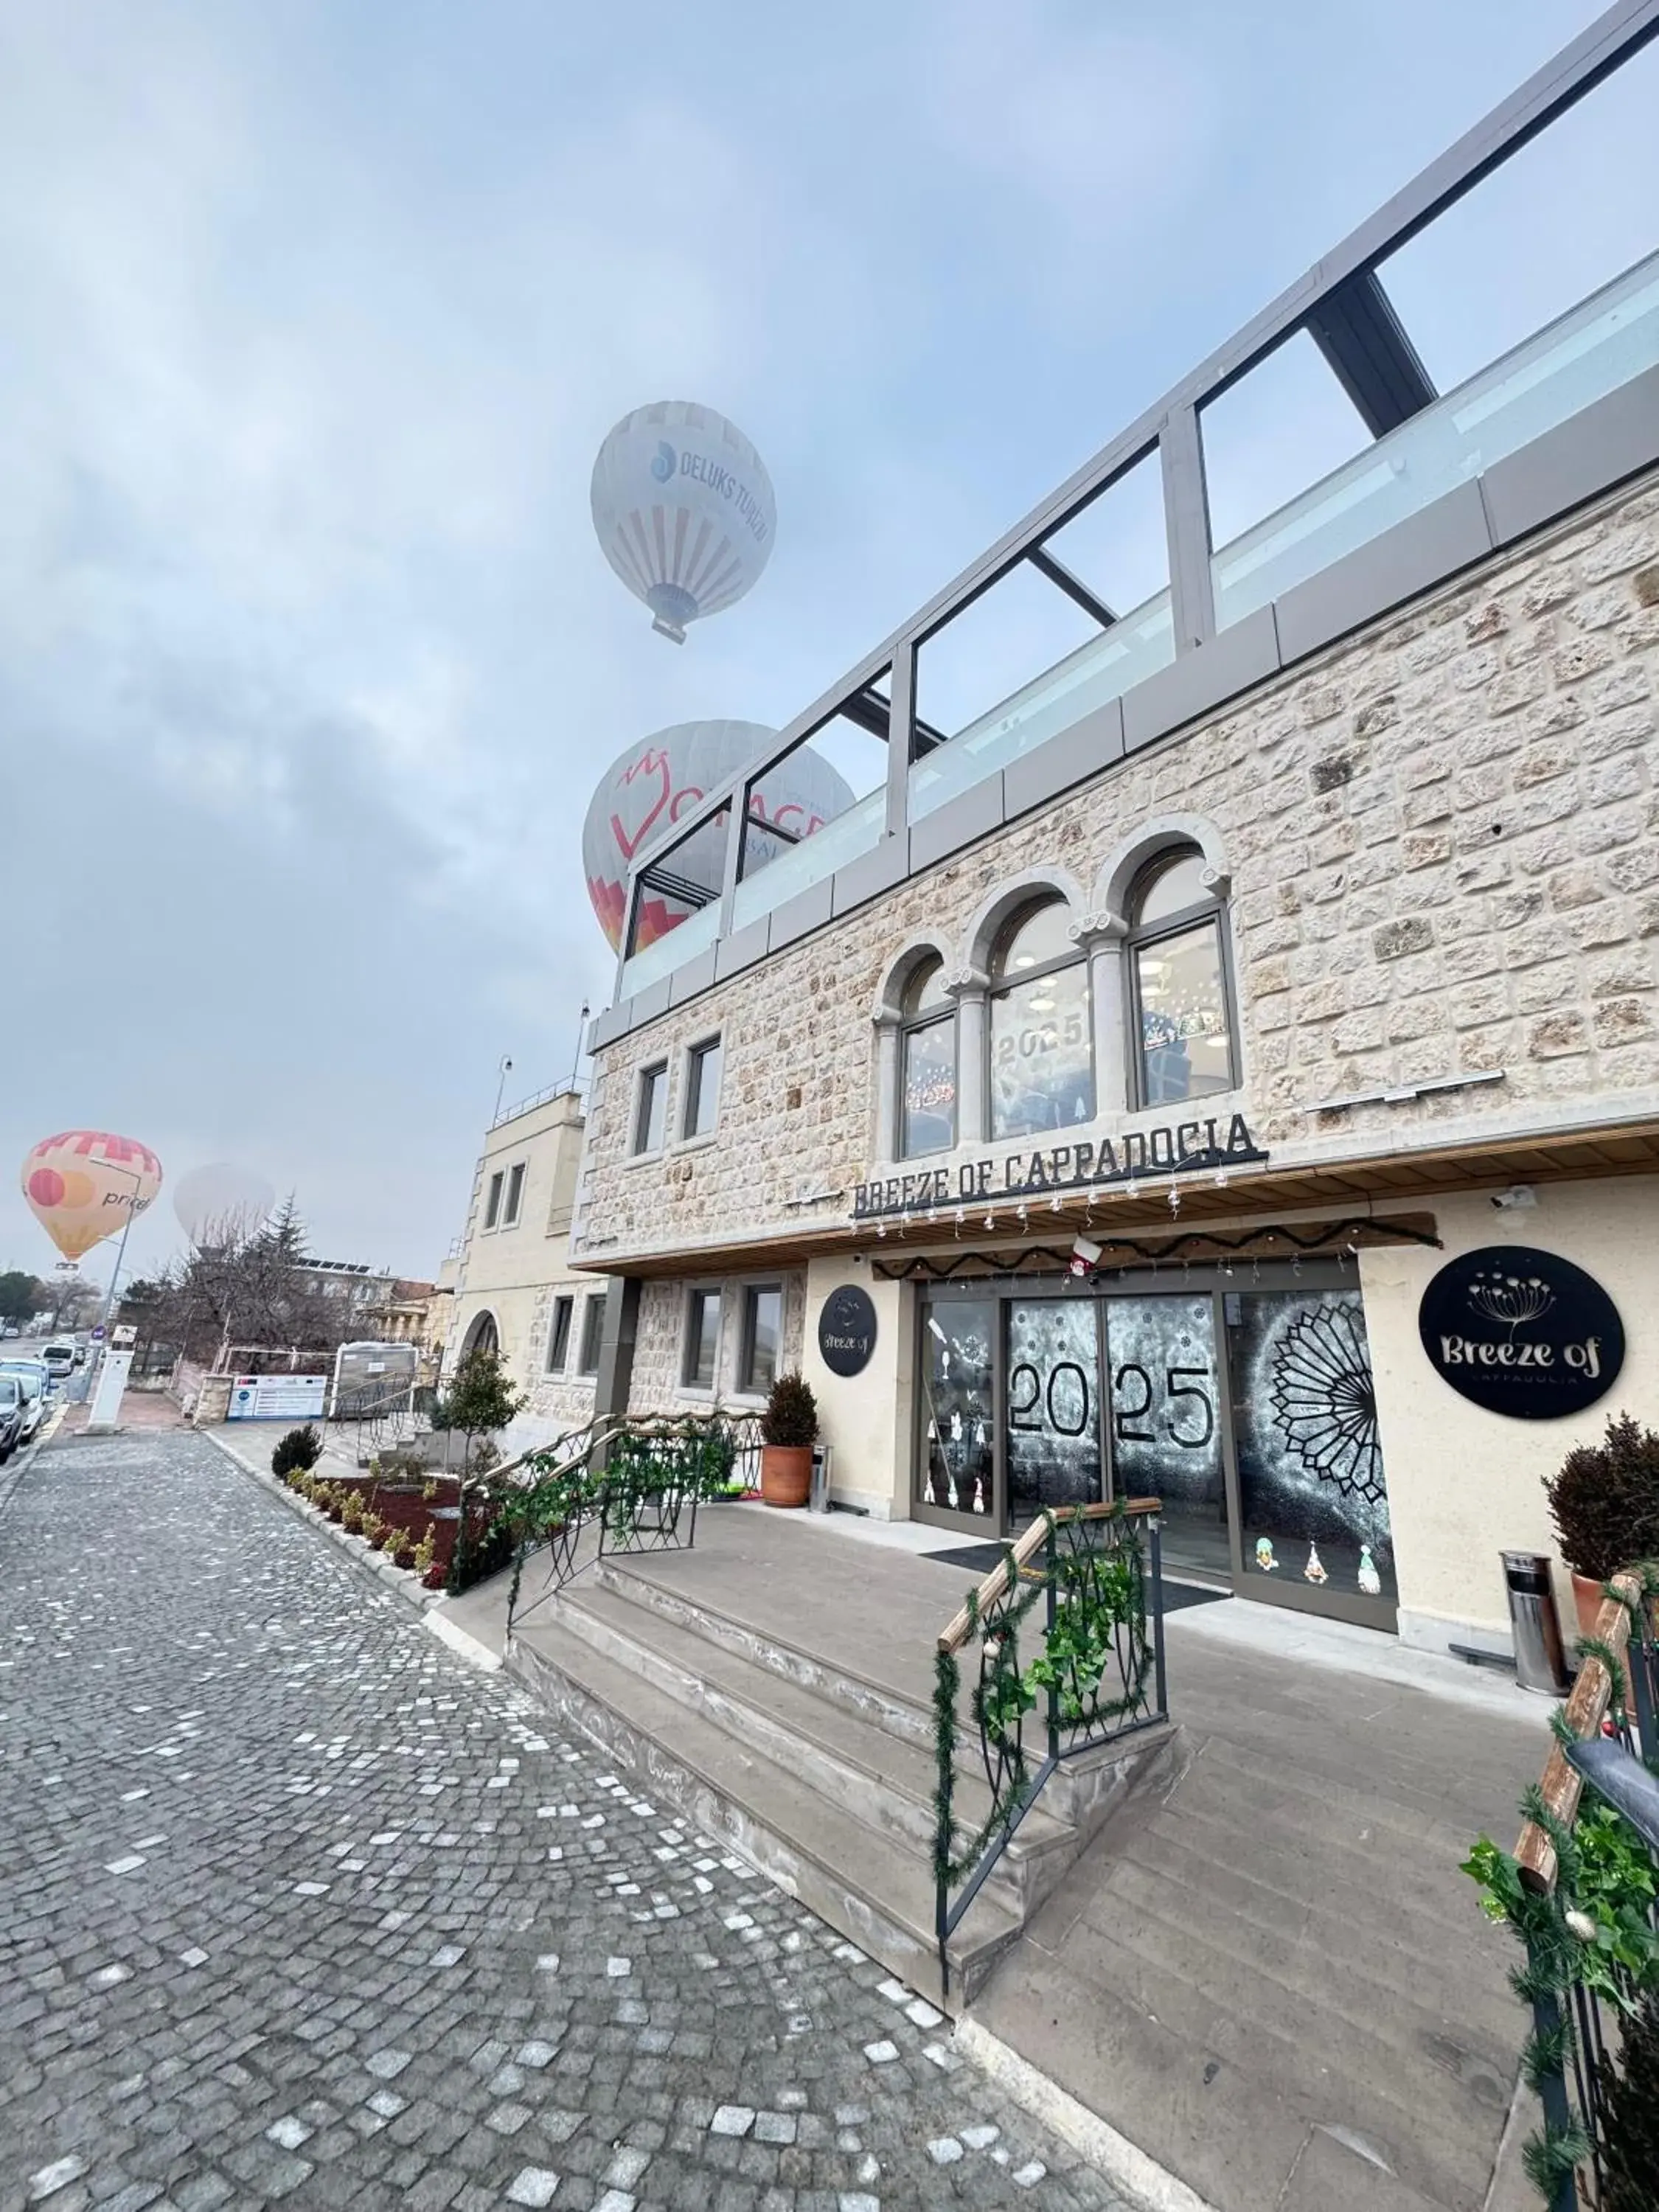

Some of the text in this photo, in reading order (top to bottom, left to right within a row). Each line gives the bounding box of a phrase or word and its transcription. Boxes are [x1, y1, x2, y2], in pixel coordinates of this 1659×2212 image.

[681, 451, 736, 500] DELUKS
[998, 1012, 1083, 1065] 2025
[854, 1113, 1256, 1211] BREEZE OF CAPPADOCIA
[1439, 1334, 1603, 1379] Breeze of
